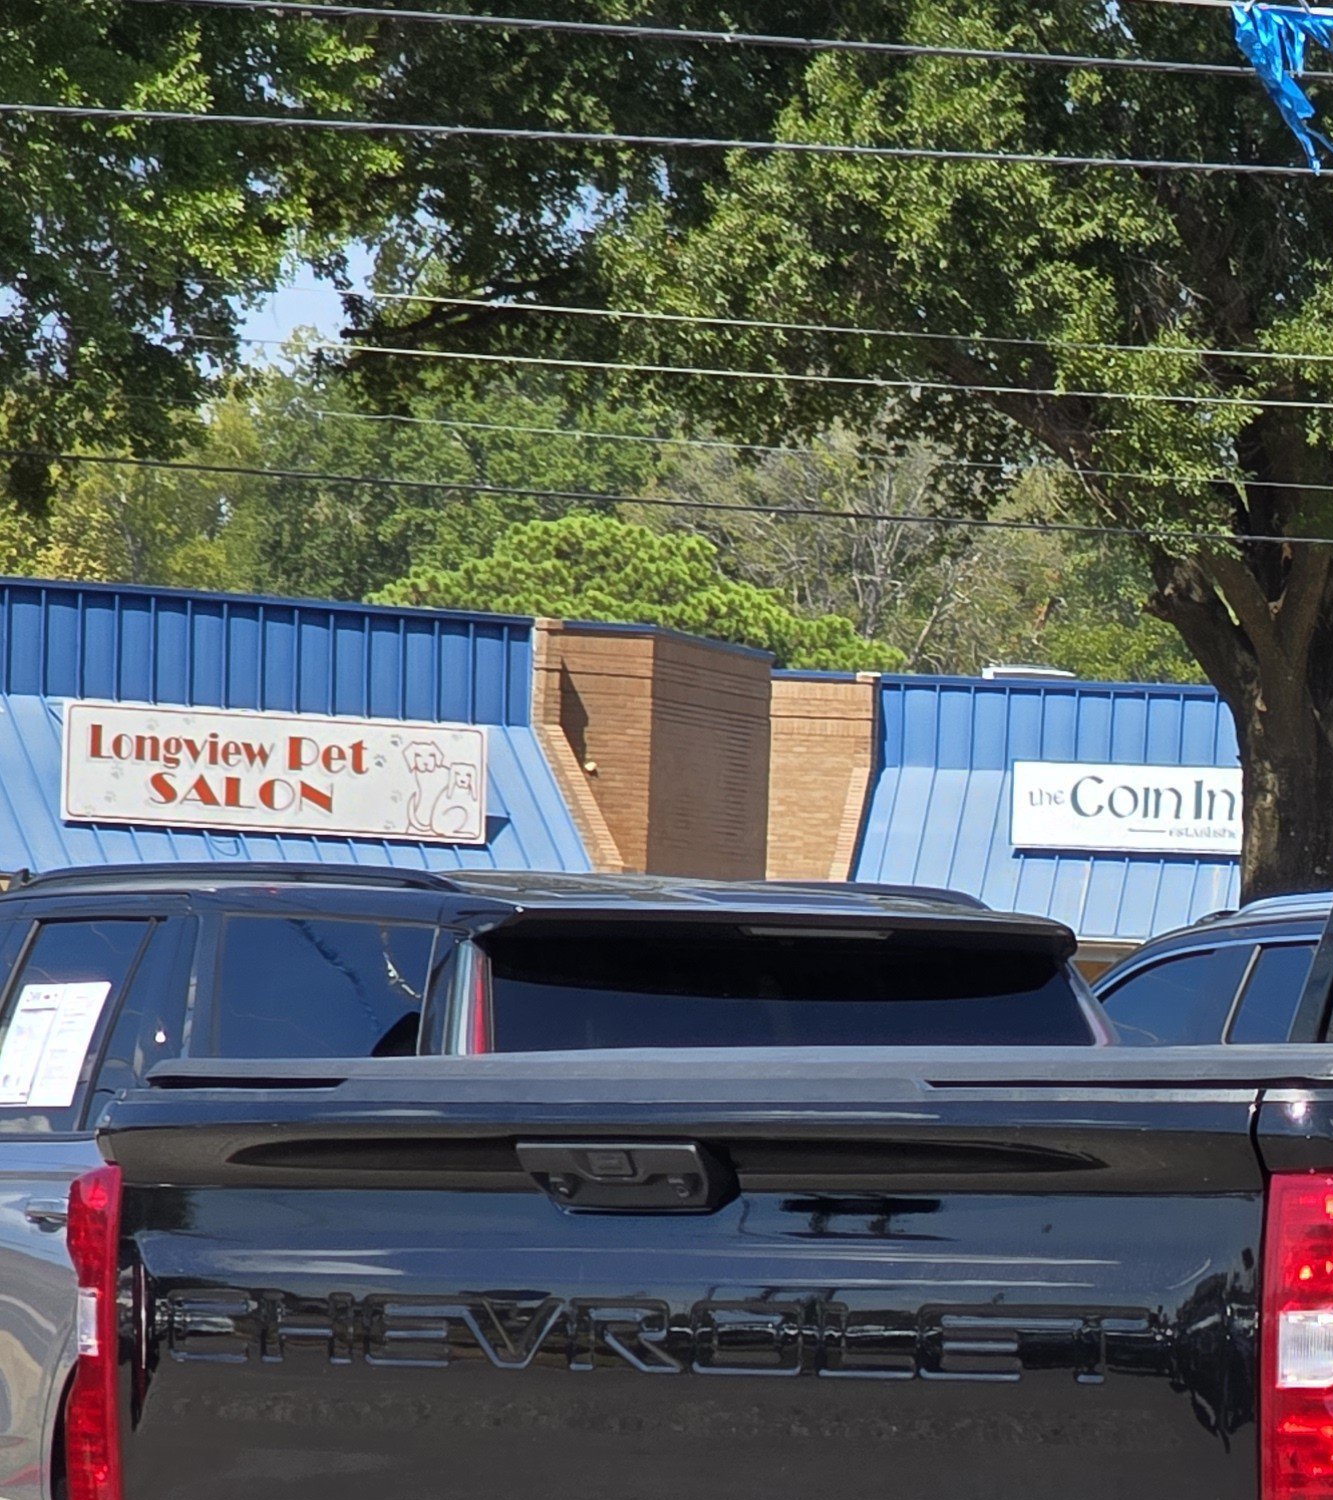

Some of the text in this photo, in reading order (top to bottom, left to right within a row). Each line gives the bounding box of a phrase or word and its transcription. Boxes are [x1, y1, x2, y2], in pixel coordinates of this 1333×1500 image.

[89, 723, 371, 775] Longview Pet
[148, 772, 335, 814] SALON
[1070, 775, 1182, 819] Coin
[1193, 779, 1237, 822] In
[167, 1287, 1151, 1384] CHEVROLET
